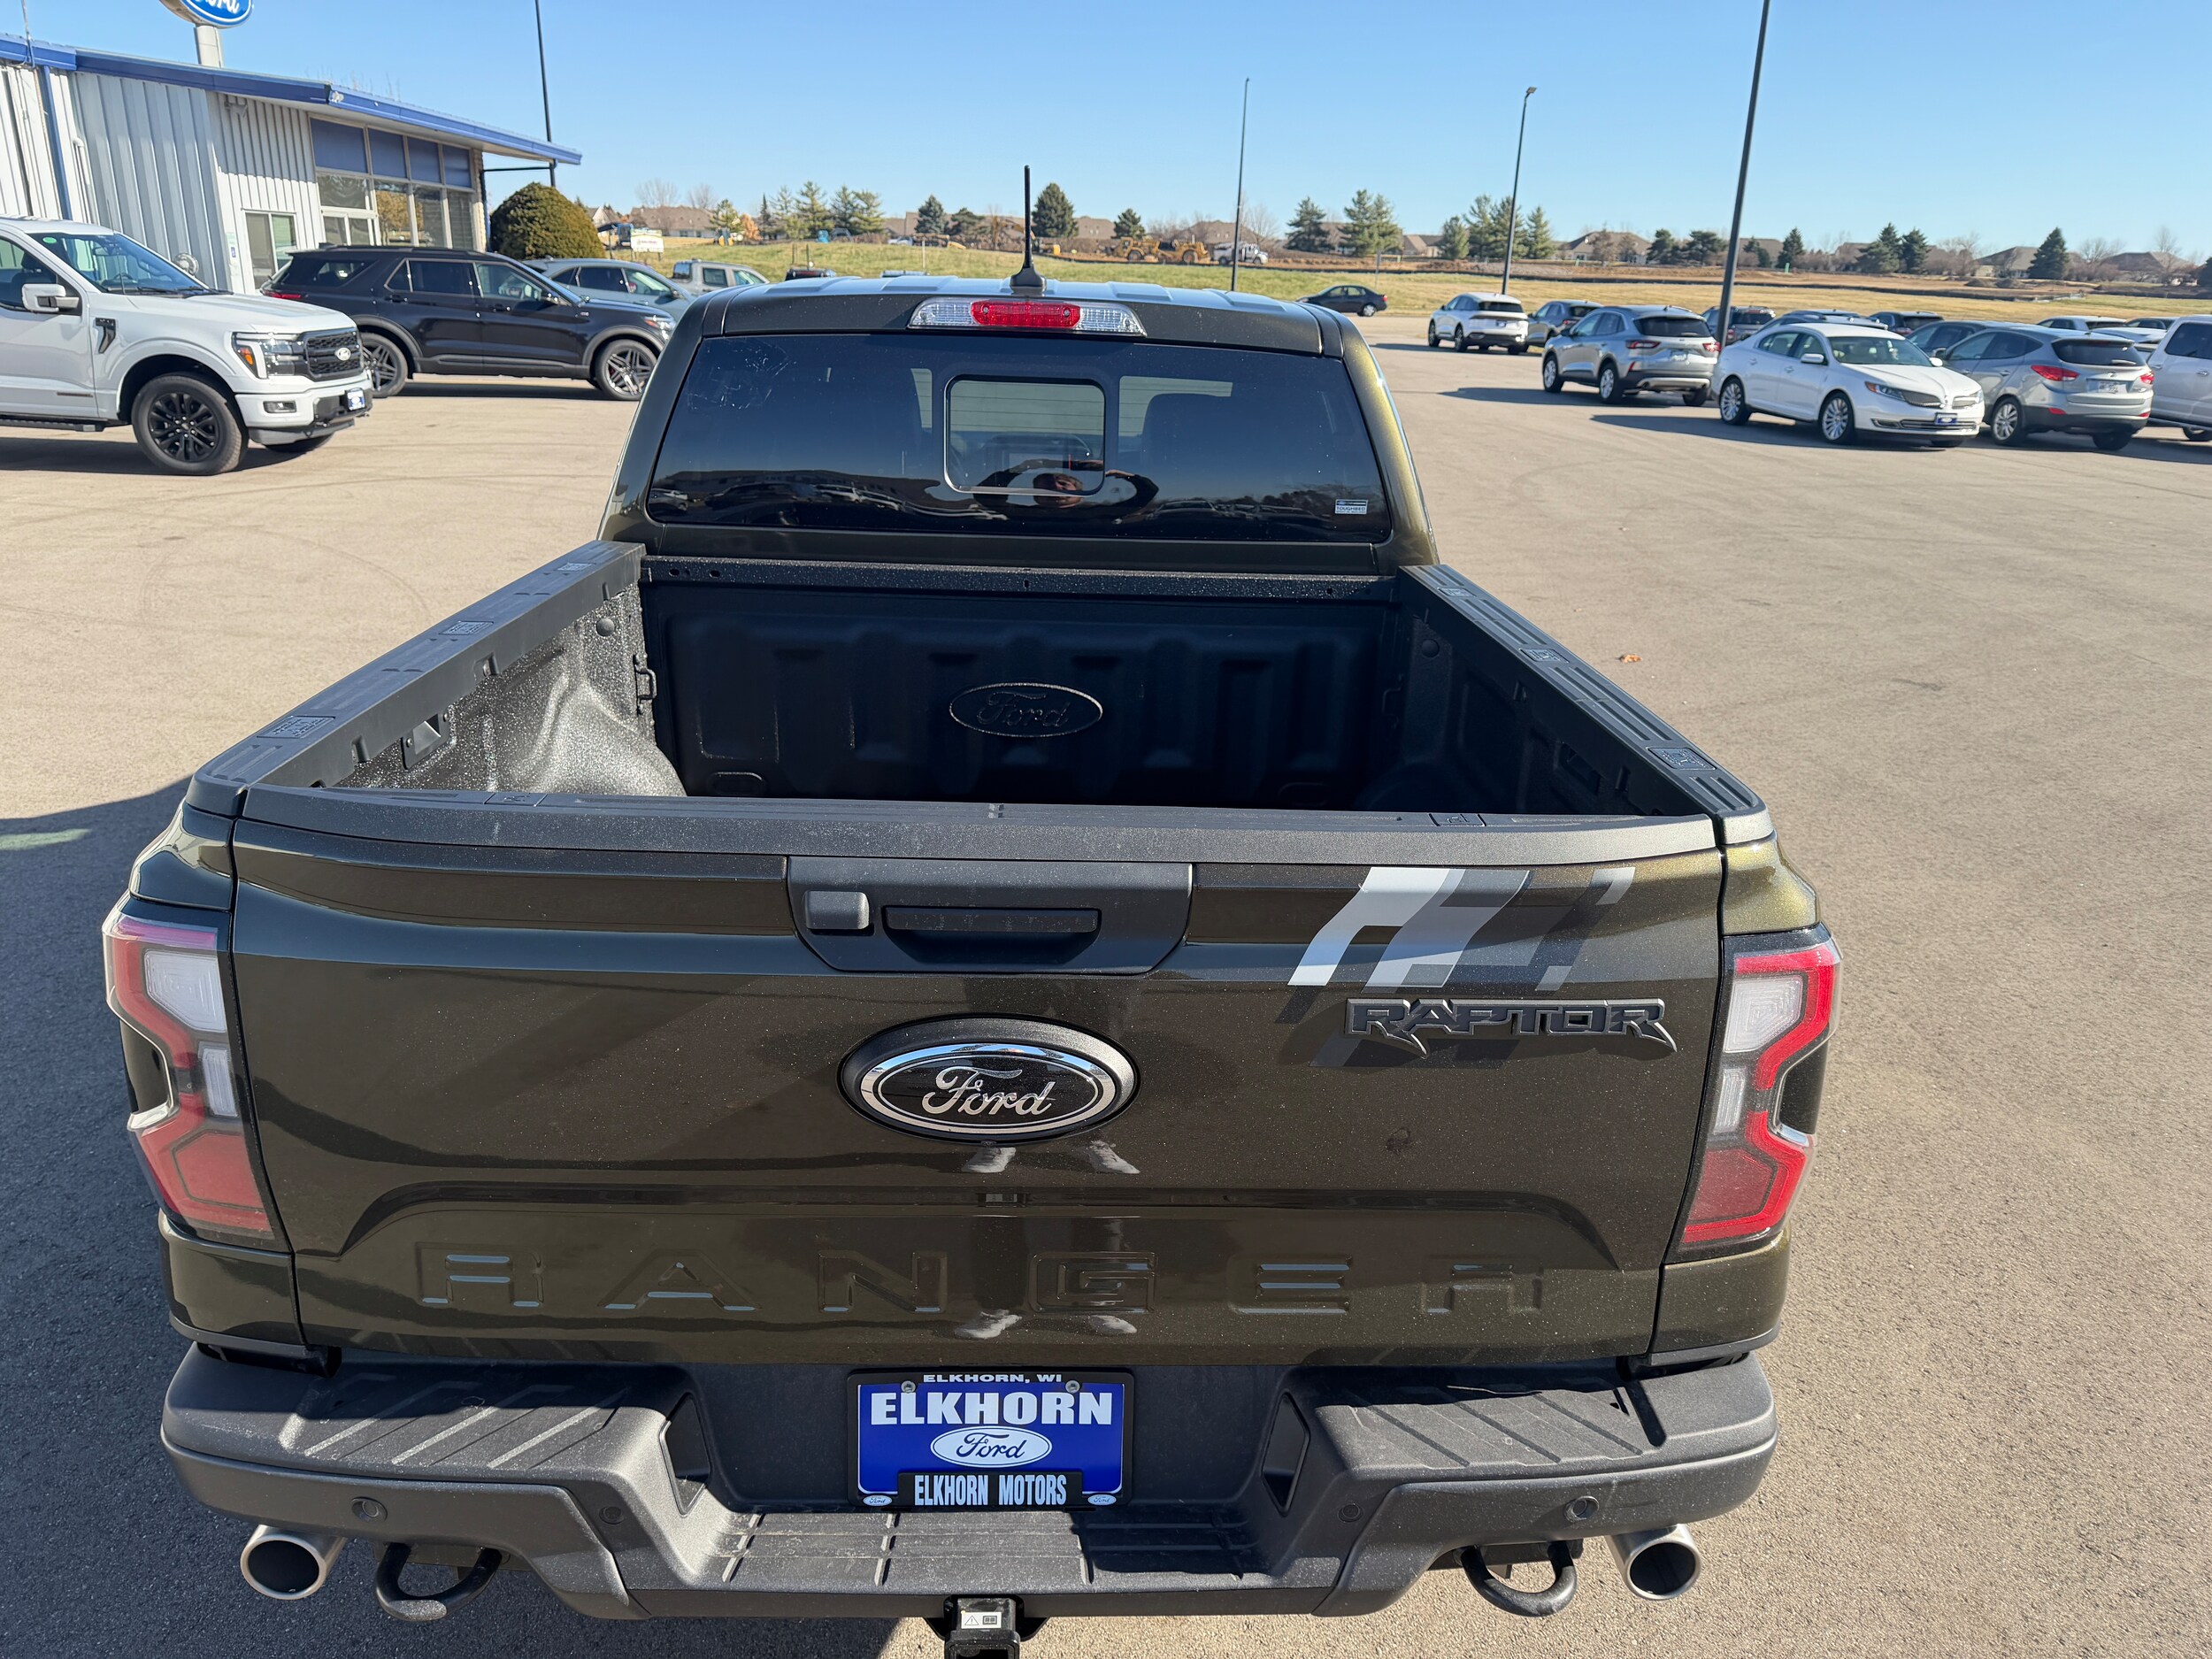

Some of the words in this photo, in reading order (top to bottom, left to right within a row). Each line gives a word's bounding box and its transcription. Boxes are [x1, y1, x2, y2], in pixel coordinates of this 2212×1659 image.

[976, 691, 1071, 727] Ford
[1344, 998, 1678, 1059] RAPTOR
[921, 1065, 1057, 1116] Ford
[416, 1242, 1544, 1315] RANGER
[923, 1374, 1030, 1383] ELKHORN,
[1036, 1374, 1062, 1383] WI
[871, 1392, 1112, 1425] ELKHORN
[956, 1432, 1027, 1458] Ford
[914, 1474, 988, 1505] ELKHORN
[998, 1474, 1067, 1505] MOTORS
